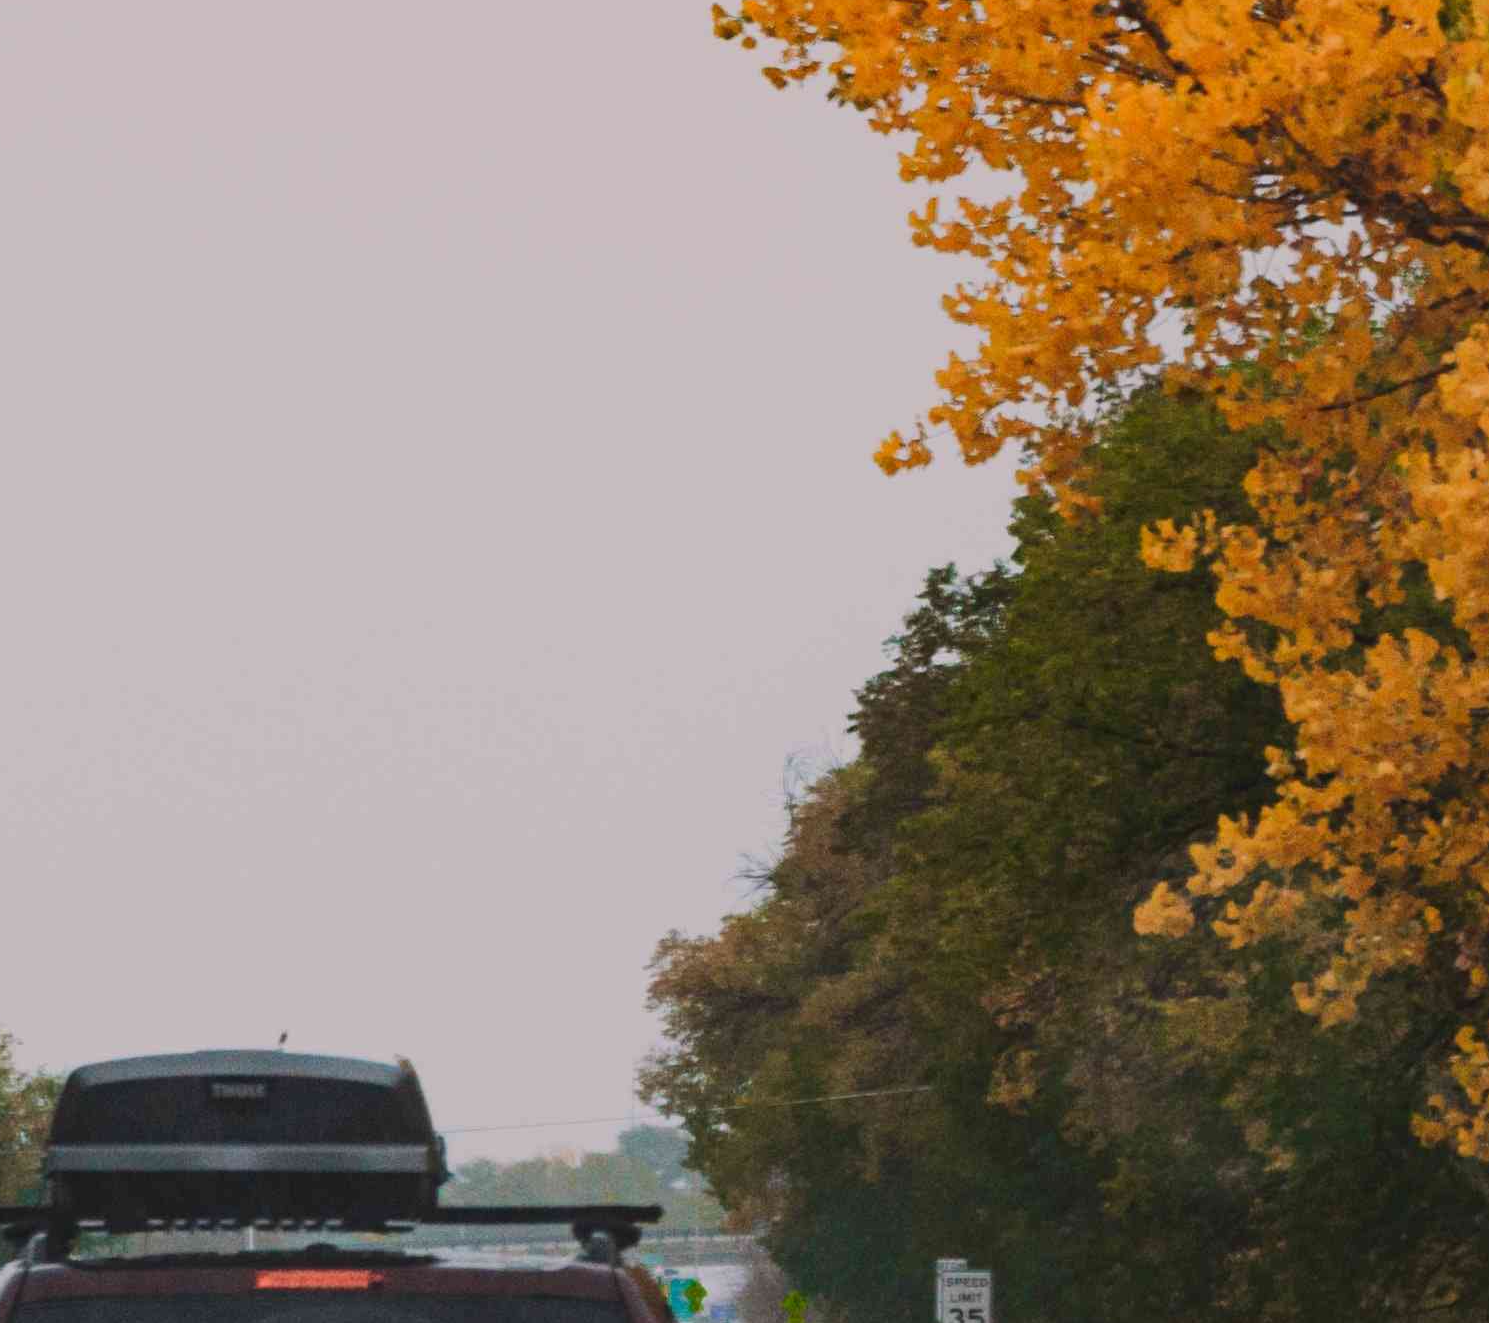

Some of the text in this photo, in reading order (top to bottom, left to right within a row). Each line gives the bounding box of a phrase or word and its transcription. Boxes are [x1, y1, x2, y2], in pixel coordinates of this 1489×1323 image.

[211, 1082, 267, 1098] THULE
[945, 1277, 989, 1288] SPEED
[950, 1292, 983, 1303] LIMIT
